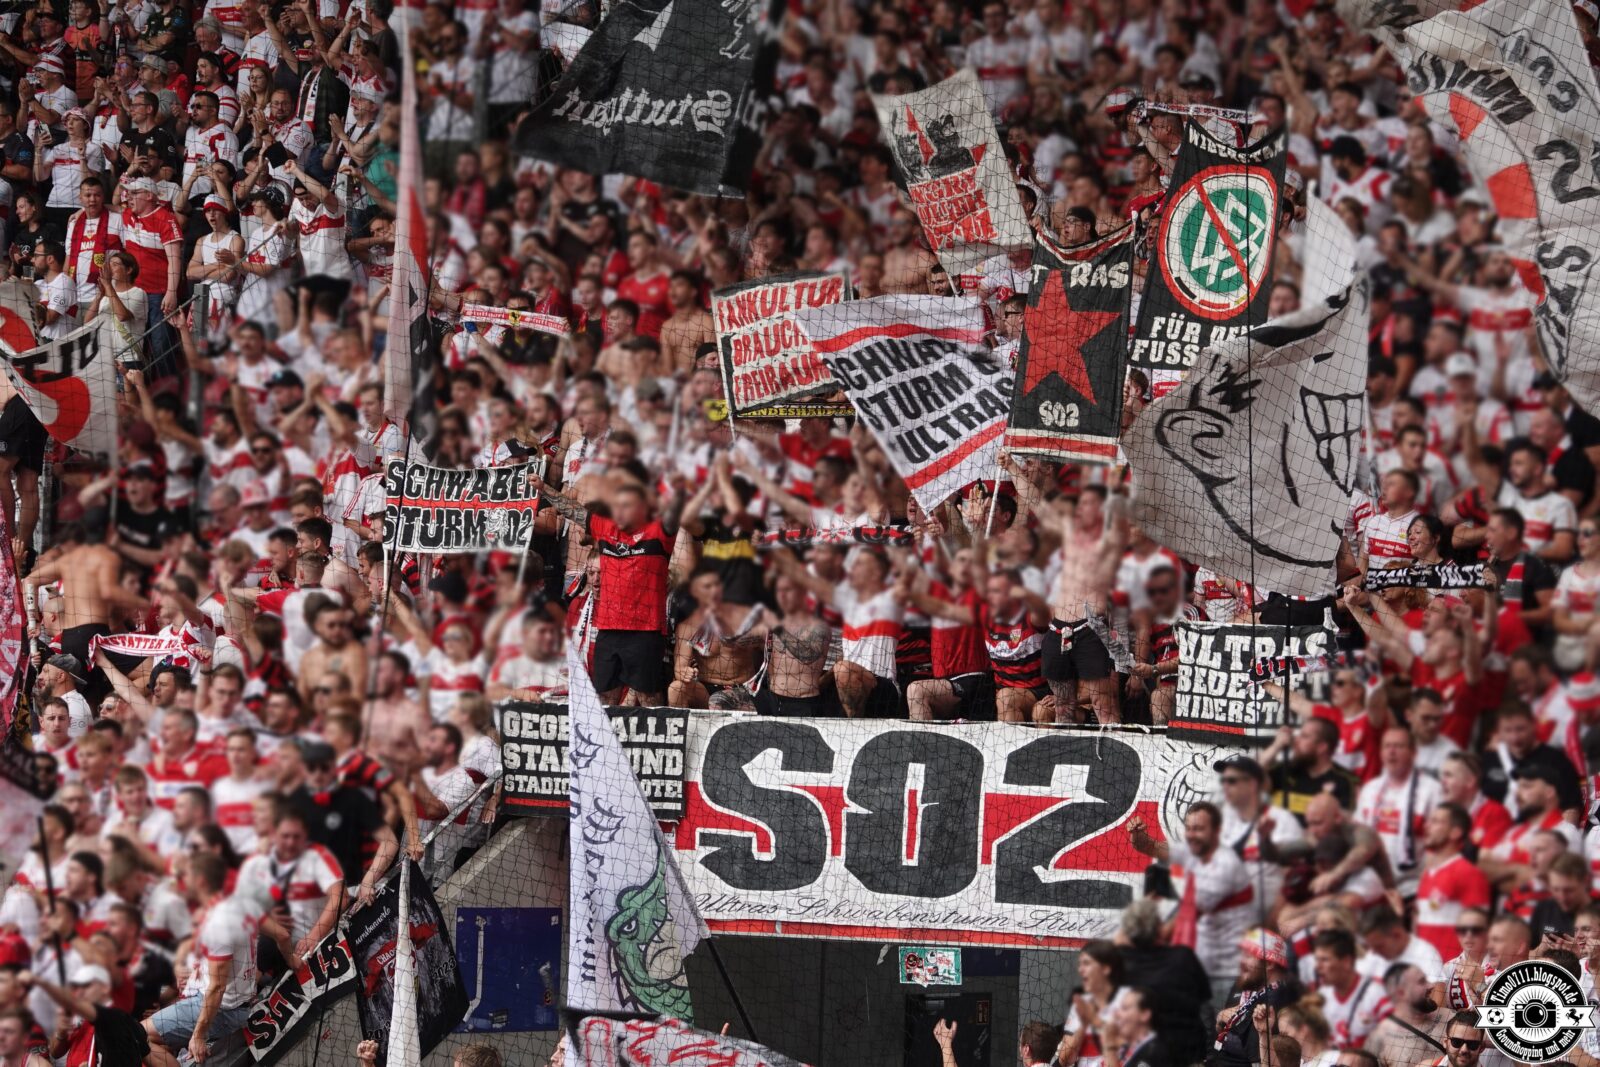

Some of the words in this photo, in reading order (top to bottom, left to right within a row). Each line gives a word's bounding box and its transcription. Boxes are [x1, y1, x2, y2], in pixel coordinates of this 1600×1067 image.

[717, 276, 843, 333] FANKULTUR
[733, 319, 809, 367] BRAUCH
[1149, 312, 1202, 344] FÜR
[823, 338, 960, 391] SCHWA
[1131, 339, 1200, 367] FUSS
[856, 362, 974, 432] STURM
[896, 376, 1015, 464] ULTRAS
[387, 460, 542, 502] SCHWABEN
[383, 505, 486, 549] STURM
[503, 710, 569, 741] GEGE
[611, 716, 685, 744] ALLE
[629, 748, 684, 776] UND
[695, 893, 779, 914] Ultras
[787, 897, 1010, 928] Schwabensturm
